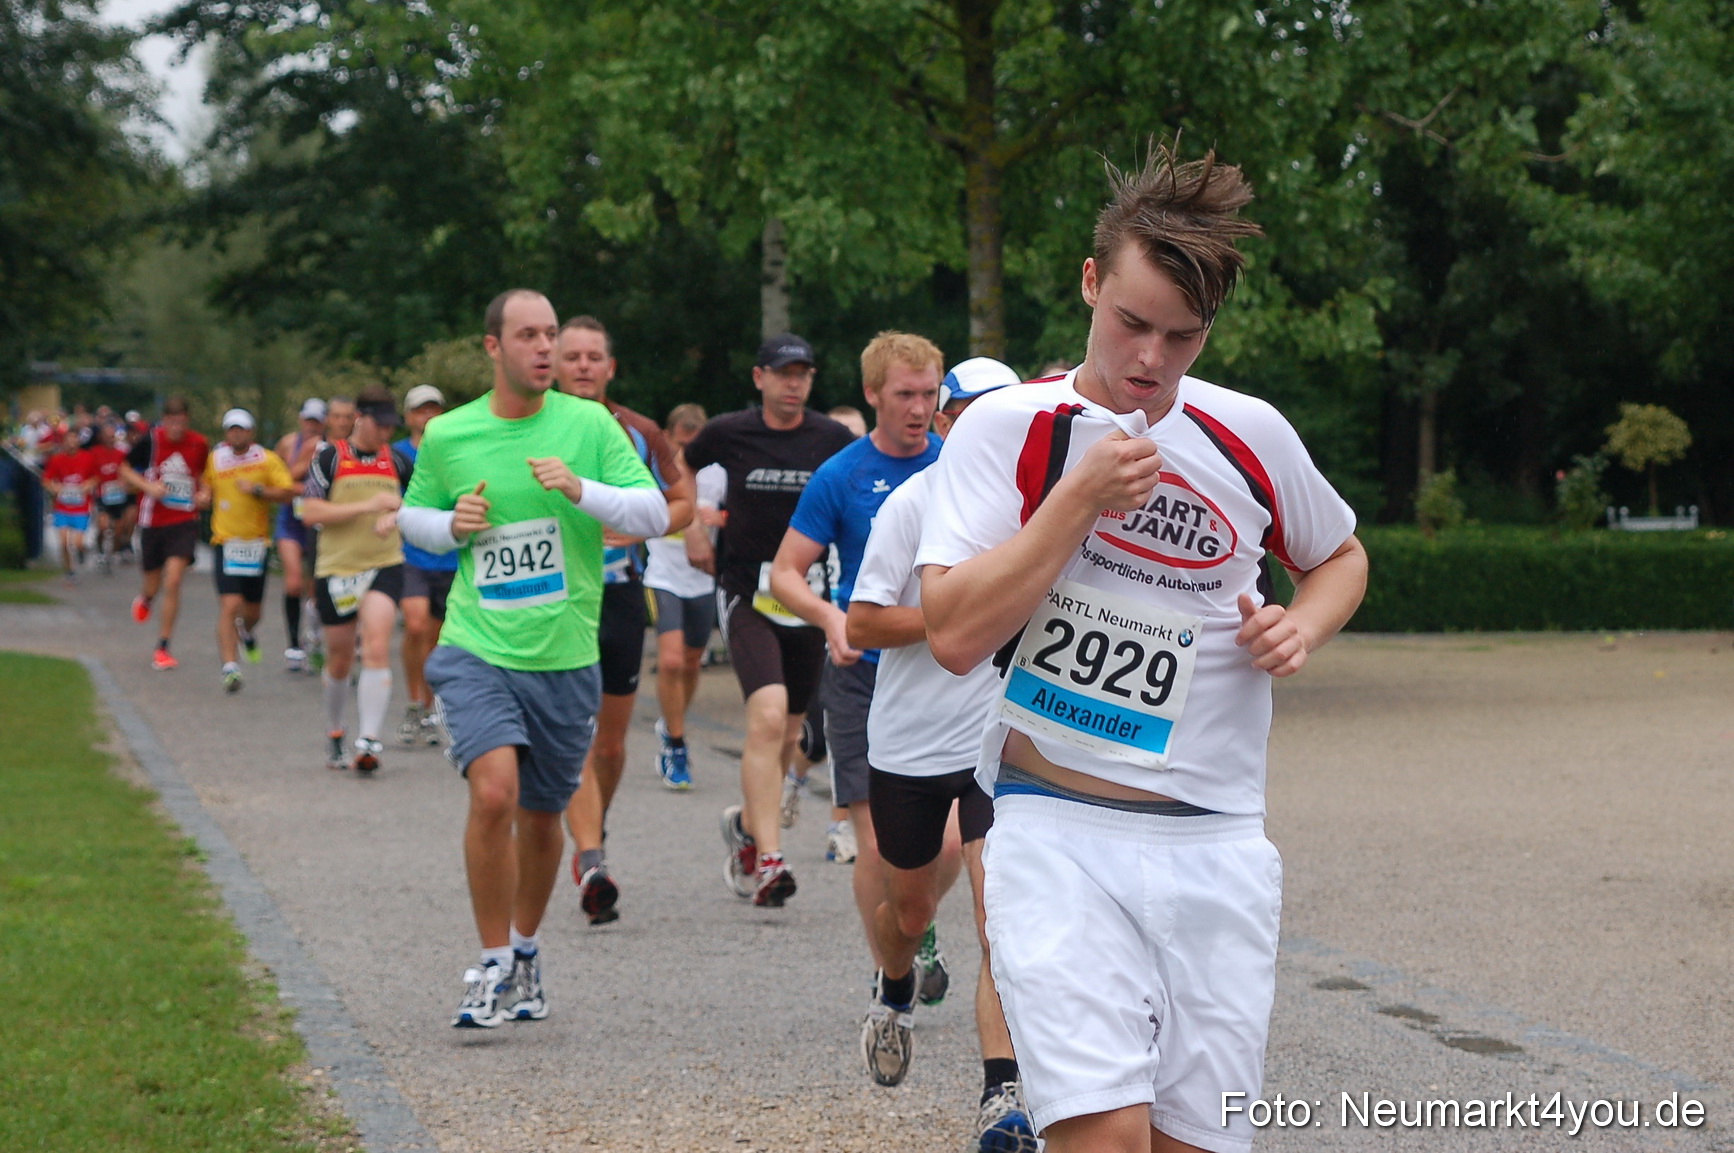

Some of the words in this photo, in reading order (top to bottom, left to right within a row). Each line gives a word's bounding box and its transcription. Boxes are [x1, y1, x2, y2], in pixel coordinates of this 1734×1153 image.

[1138, 494, 1208, 529] ART
[1209, 519, 1218, 532] &
[1121, 513, 1221, 558] JÄNIG
[484, 540, 555, 580] 2942
[1155, 574, 1223, 593] Autohaus
[1097, 608, 1174, 642] Neumarkt
[1032, 618, 1178, 707] 2929
[1031, 687, 1143, 741] Alexander
